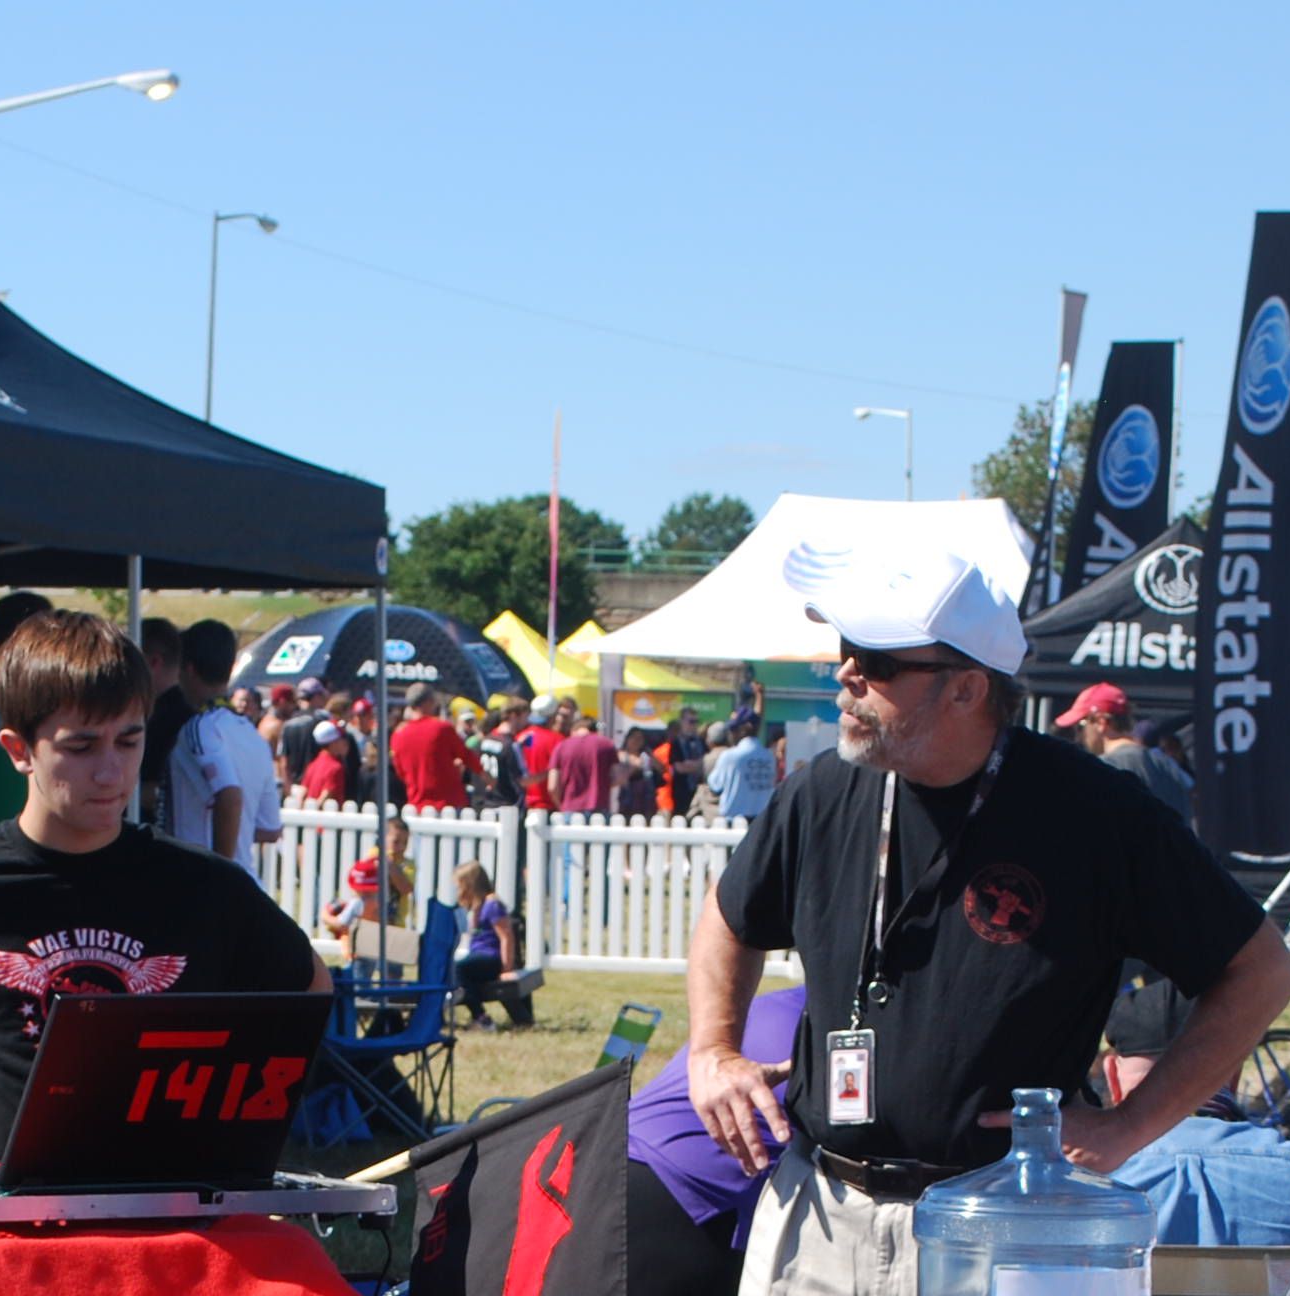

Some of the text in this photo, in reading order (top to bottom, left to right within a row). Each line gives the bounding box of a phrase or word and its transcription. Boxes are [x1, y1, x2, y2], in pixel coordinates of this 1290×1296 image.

[1214, 442, 1274, 753] Allstate
[357, 659, 438, 681] Alstate
[26, 928, 145, 959] VAE VICTIS
[126, 1057, 307, 1122] 1418
